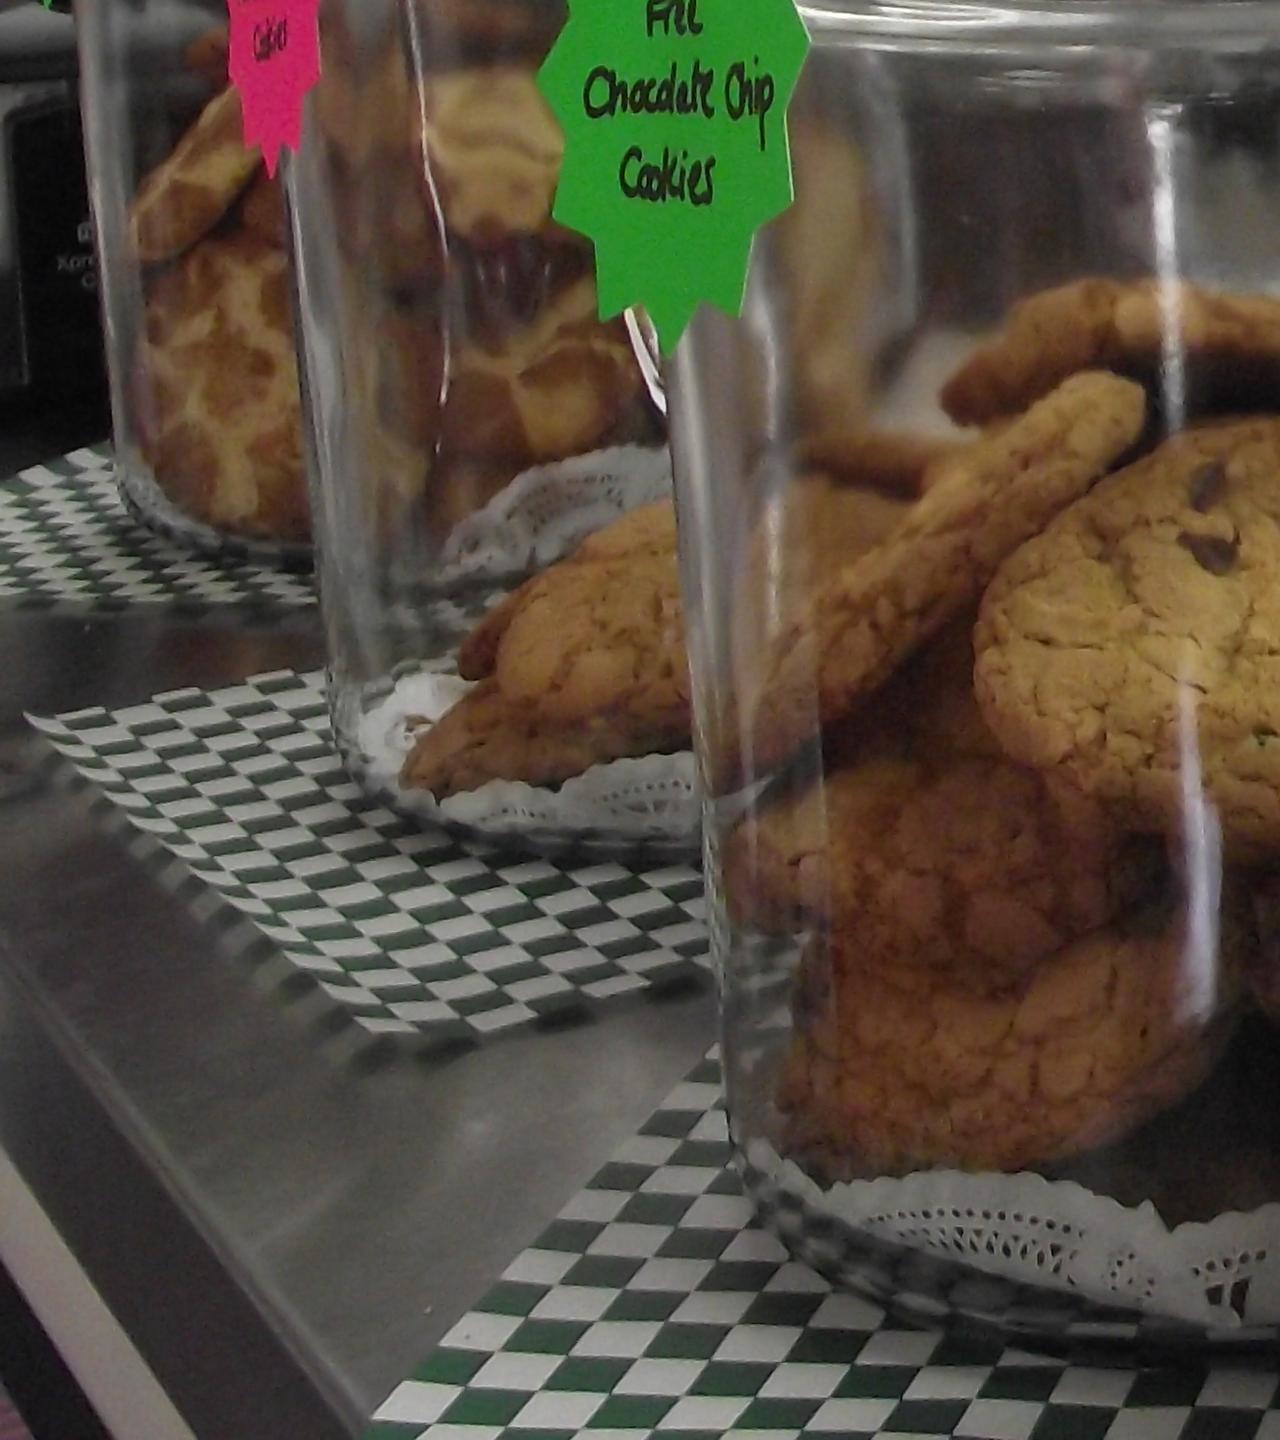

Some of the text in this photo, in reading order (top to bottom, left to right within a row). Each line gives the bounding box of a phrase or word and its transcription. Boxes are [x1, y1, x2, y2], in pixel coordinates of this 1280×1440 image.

[253, 17, 287, 62] Cookies
[583, 55, 775, 152] Chocolate Chip
[618, 145, 716, 207] Cookies
